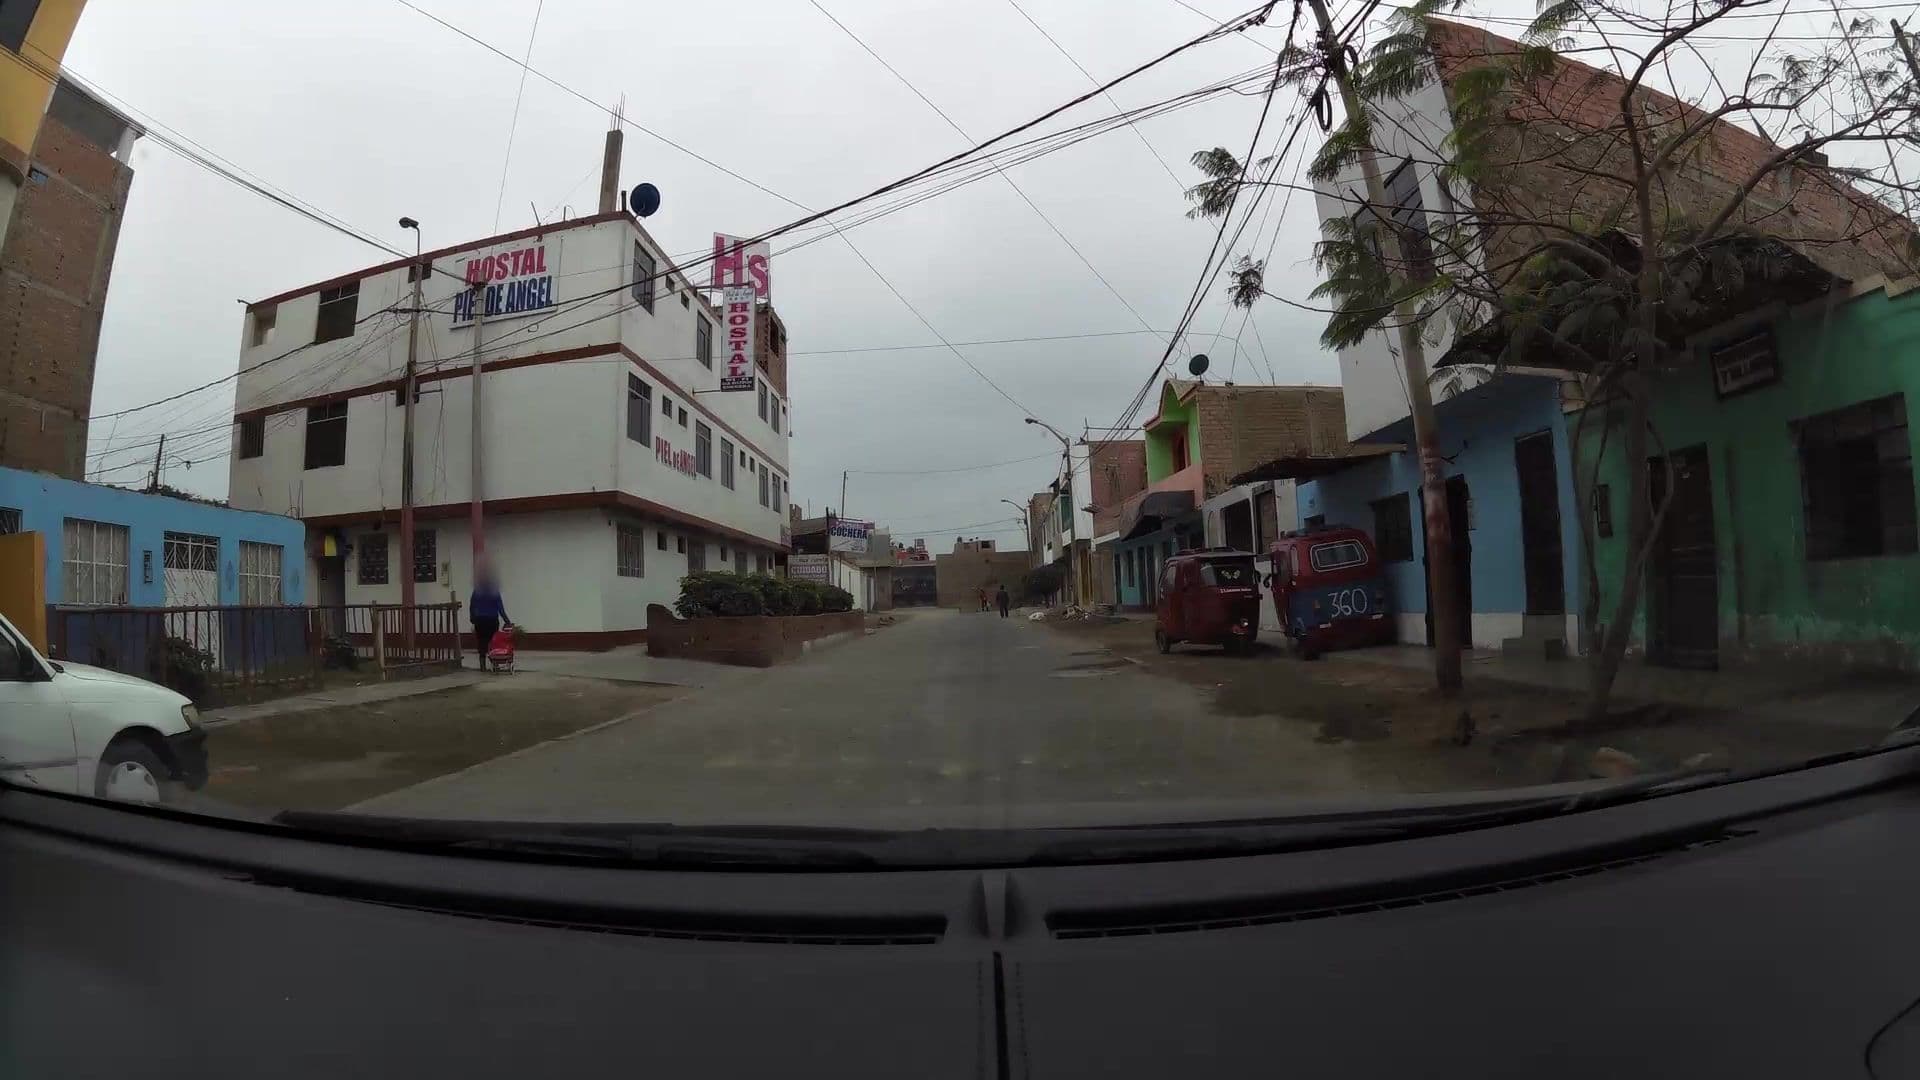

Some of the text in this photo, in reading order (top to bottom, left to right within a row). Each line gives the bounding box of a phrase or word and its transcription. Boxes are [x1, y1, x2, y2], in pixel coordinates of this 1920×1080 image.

[465, 246, 547, 288] HOSTAL
[453, 275, 553, 323] PIE DE ANGEL
[728, 303, 749, 377] HOSTAL
[656, 435, 672, 467] PIEL
[830, 526, 868, 540] COCHERA
[1328, 588, 1368, 618] 360
